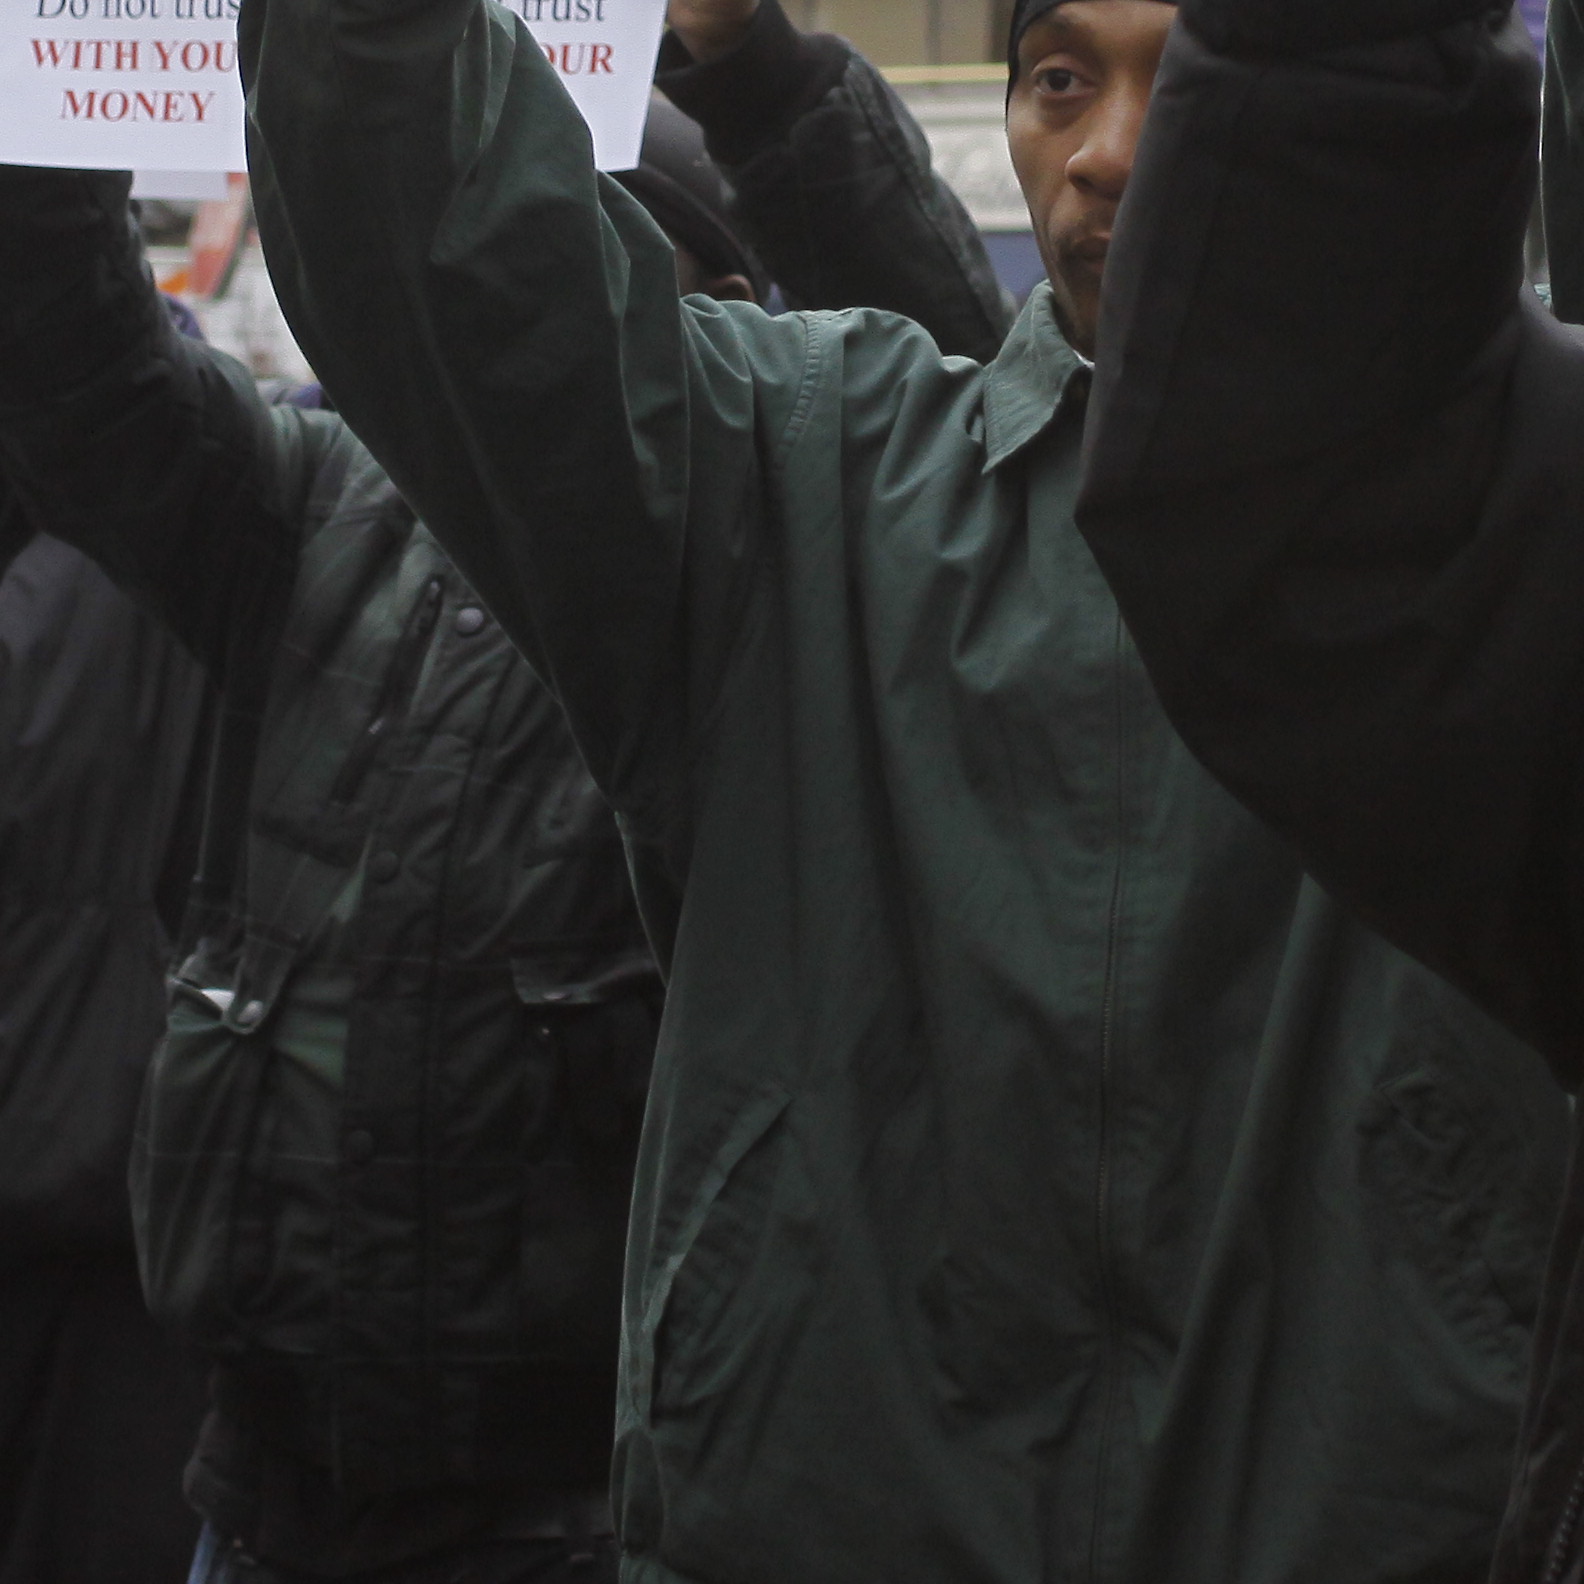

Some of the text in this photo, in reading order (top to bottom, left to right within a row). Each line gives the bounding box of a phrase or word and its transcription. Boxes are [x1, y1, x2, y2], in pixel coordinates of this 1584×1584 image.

[32, 39, 238, 72] WITH YOU
[60, 90, 216, 123] MONEY
